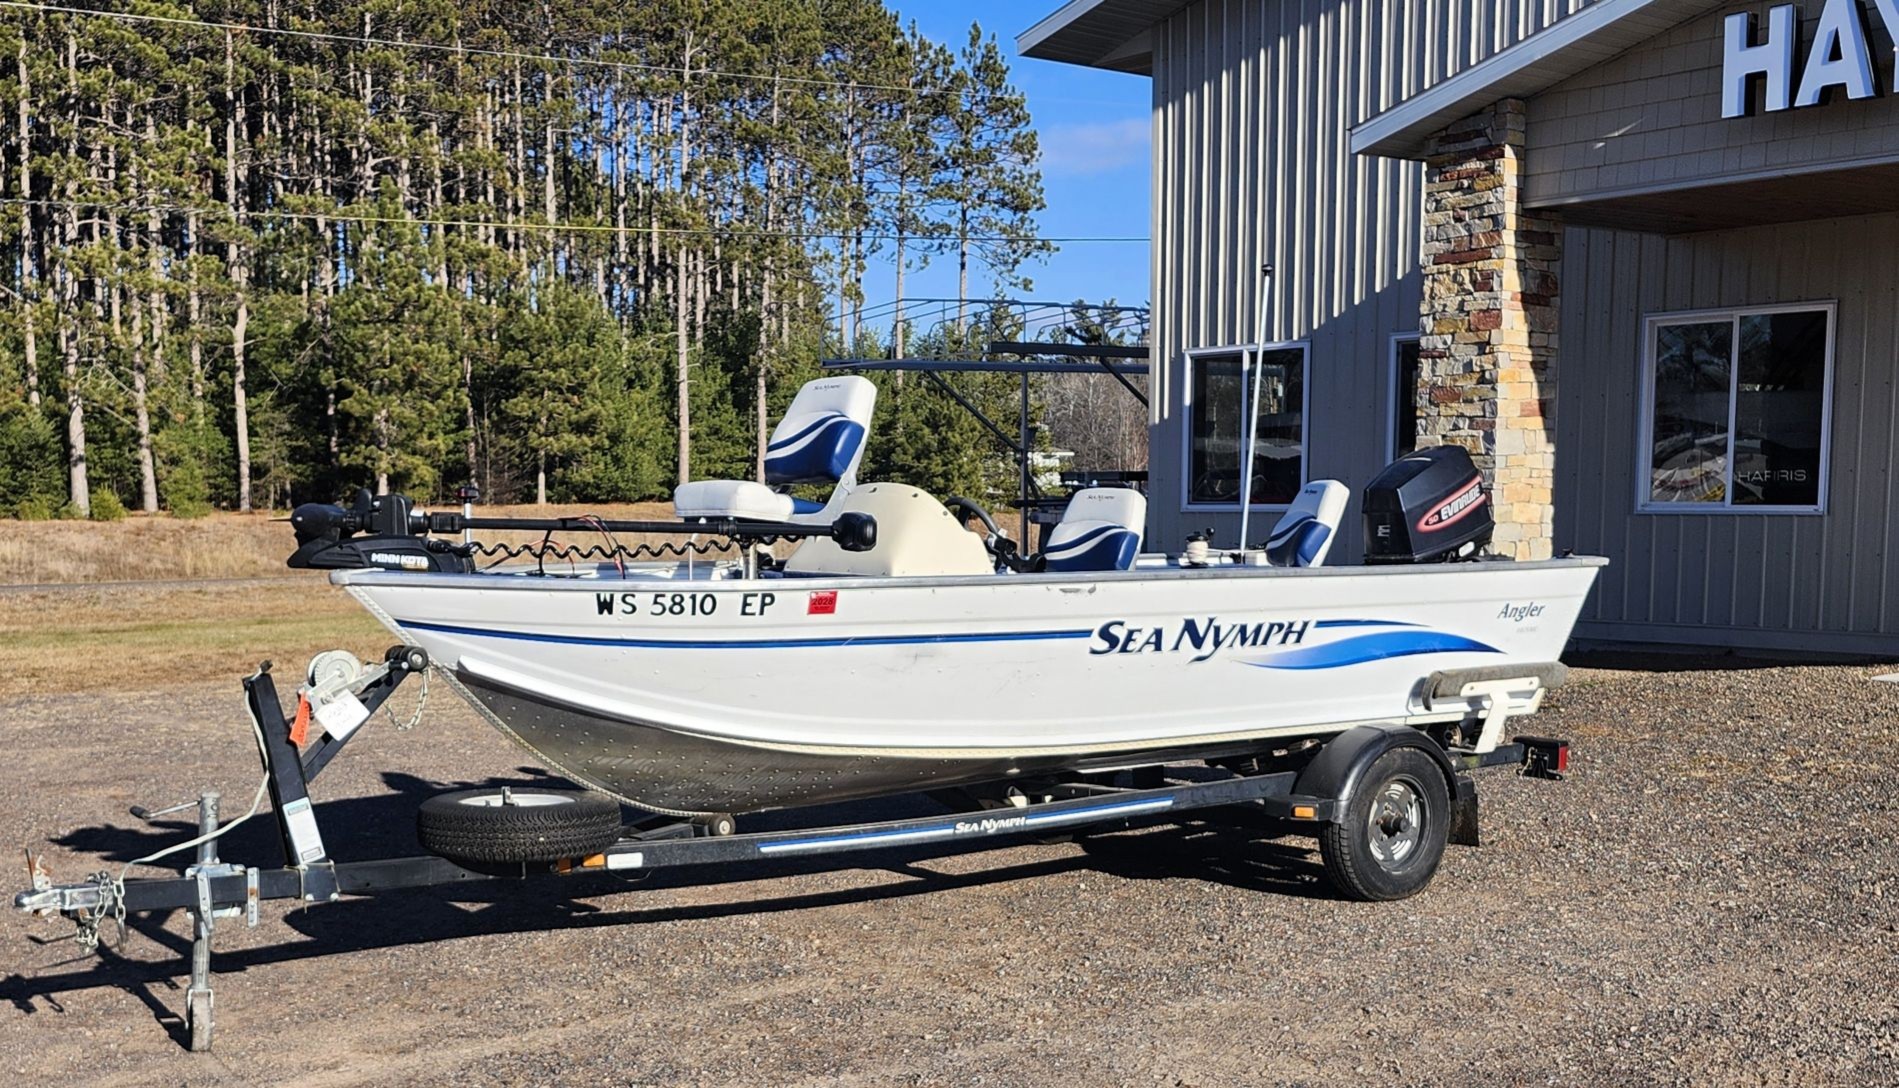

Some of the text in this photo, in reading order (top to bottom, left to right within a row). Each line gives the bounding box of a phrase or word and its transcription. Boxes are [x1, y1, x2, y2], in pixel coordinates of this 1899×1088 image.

[1441, 484, 1481, 520] EVINRUDE
[371, 553, 429, 567] MINN KOTA
[596, 592, 776, 616] WS 5810 EP
[1496, 601, 1546, 622] Angler
[1089, 616, 1312, 664] SEA NYMPH
[954, 816, 1026, 834] SEA NYMPH
